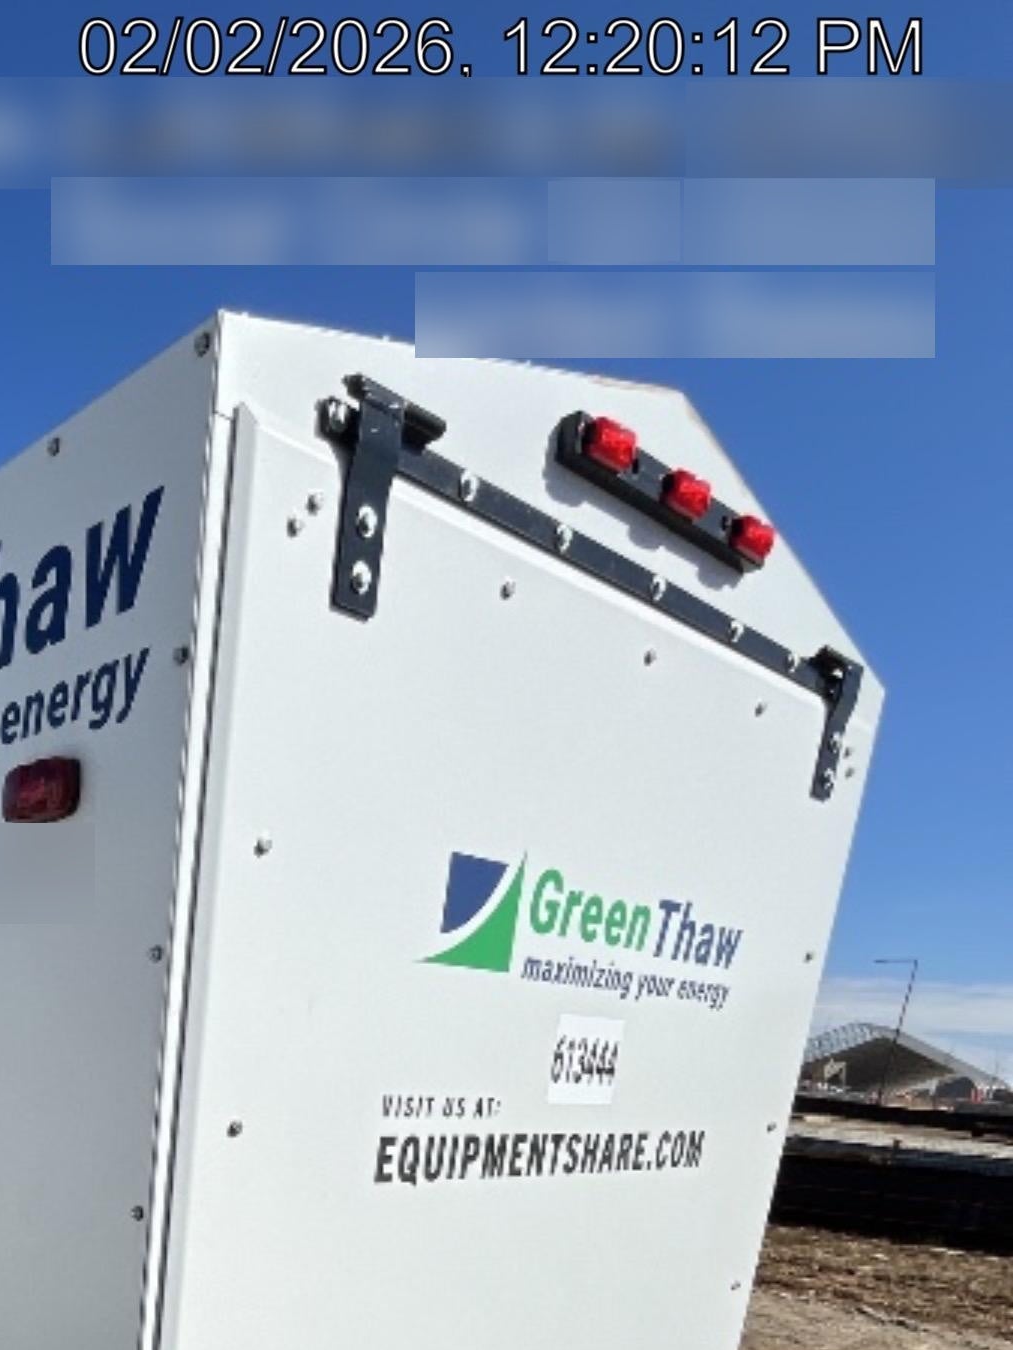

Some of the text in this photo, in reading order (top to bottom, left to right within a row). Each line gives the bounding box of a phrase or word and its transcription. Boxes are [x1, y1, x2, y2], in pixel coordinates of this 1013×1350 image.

[0, 647, 150, 745] energy
[520, 956, 731, 1011] maximizing your energy
[550, 1034, 619, 1086] 613444
[382, 1095, 502, 1119] VISIT US AT:
[374, 1130, 706, 1187] EQUIPMENTSHARE.COM
